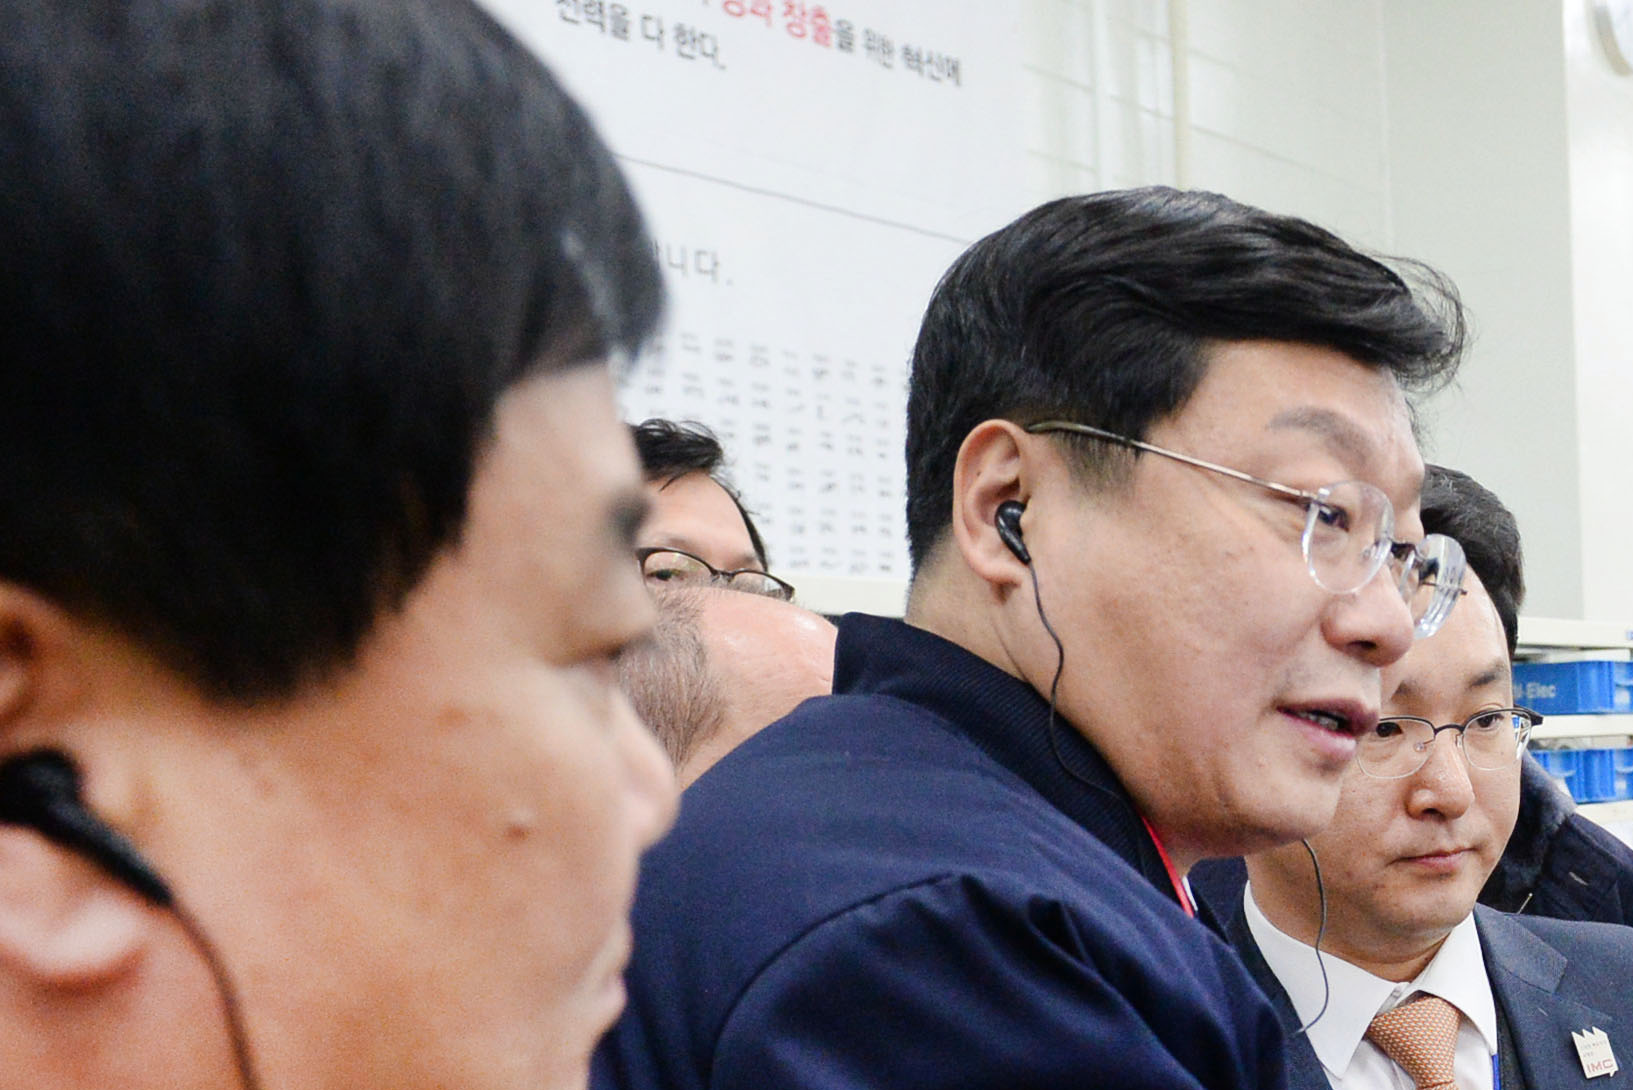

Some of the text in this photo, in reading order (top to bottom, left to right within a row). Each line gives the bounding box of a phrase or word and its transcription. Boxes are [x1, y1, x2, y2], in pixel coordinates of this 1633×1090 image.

[641, 14, 664, 50] 다
[674, 23, 726, 70] 한다.
[901, 44, 961, 86] 혁신에
[654, 241, 734, 286] 니다.
